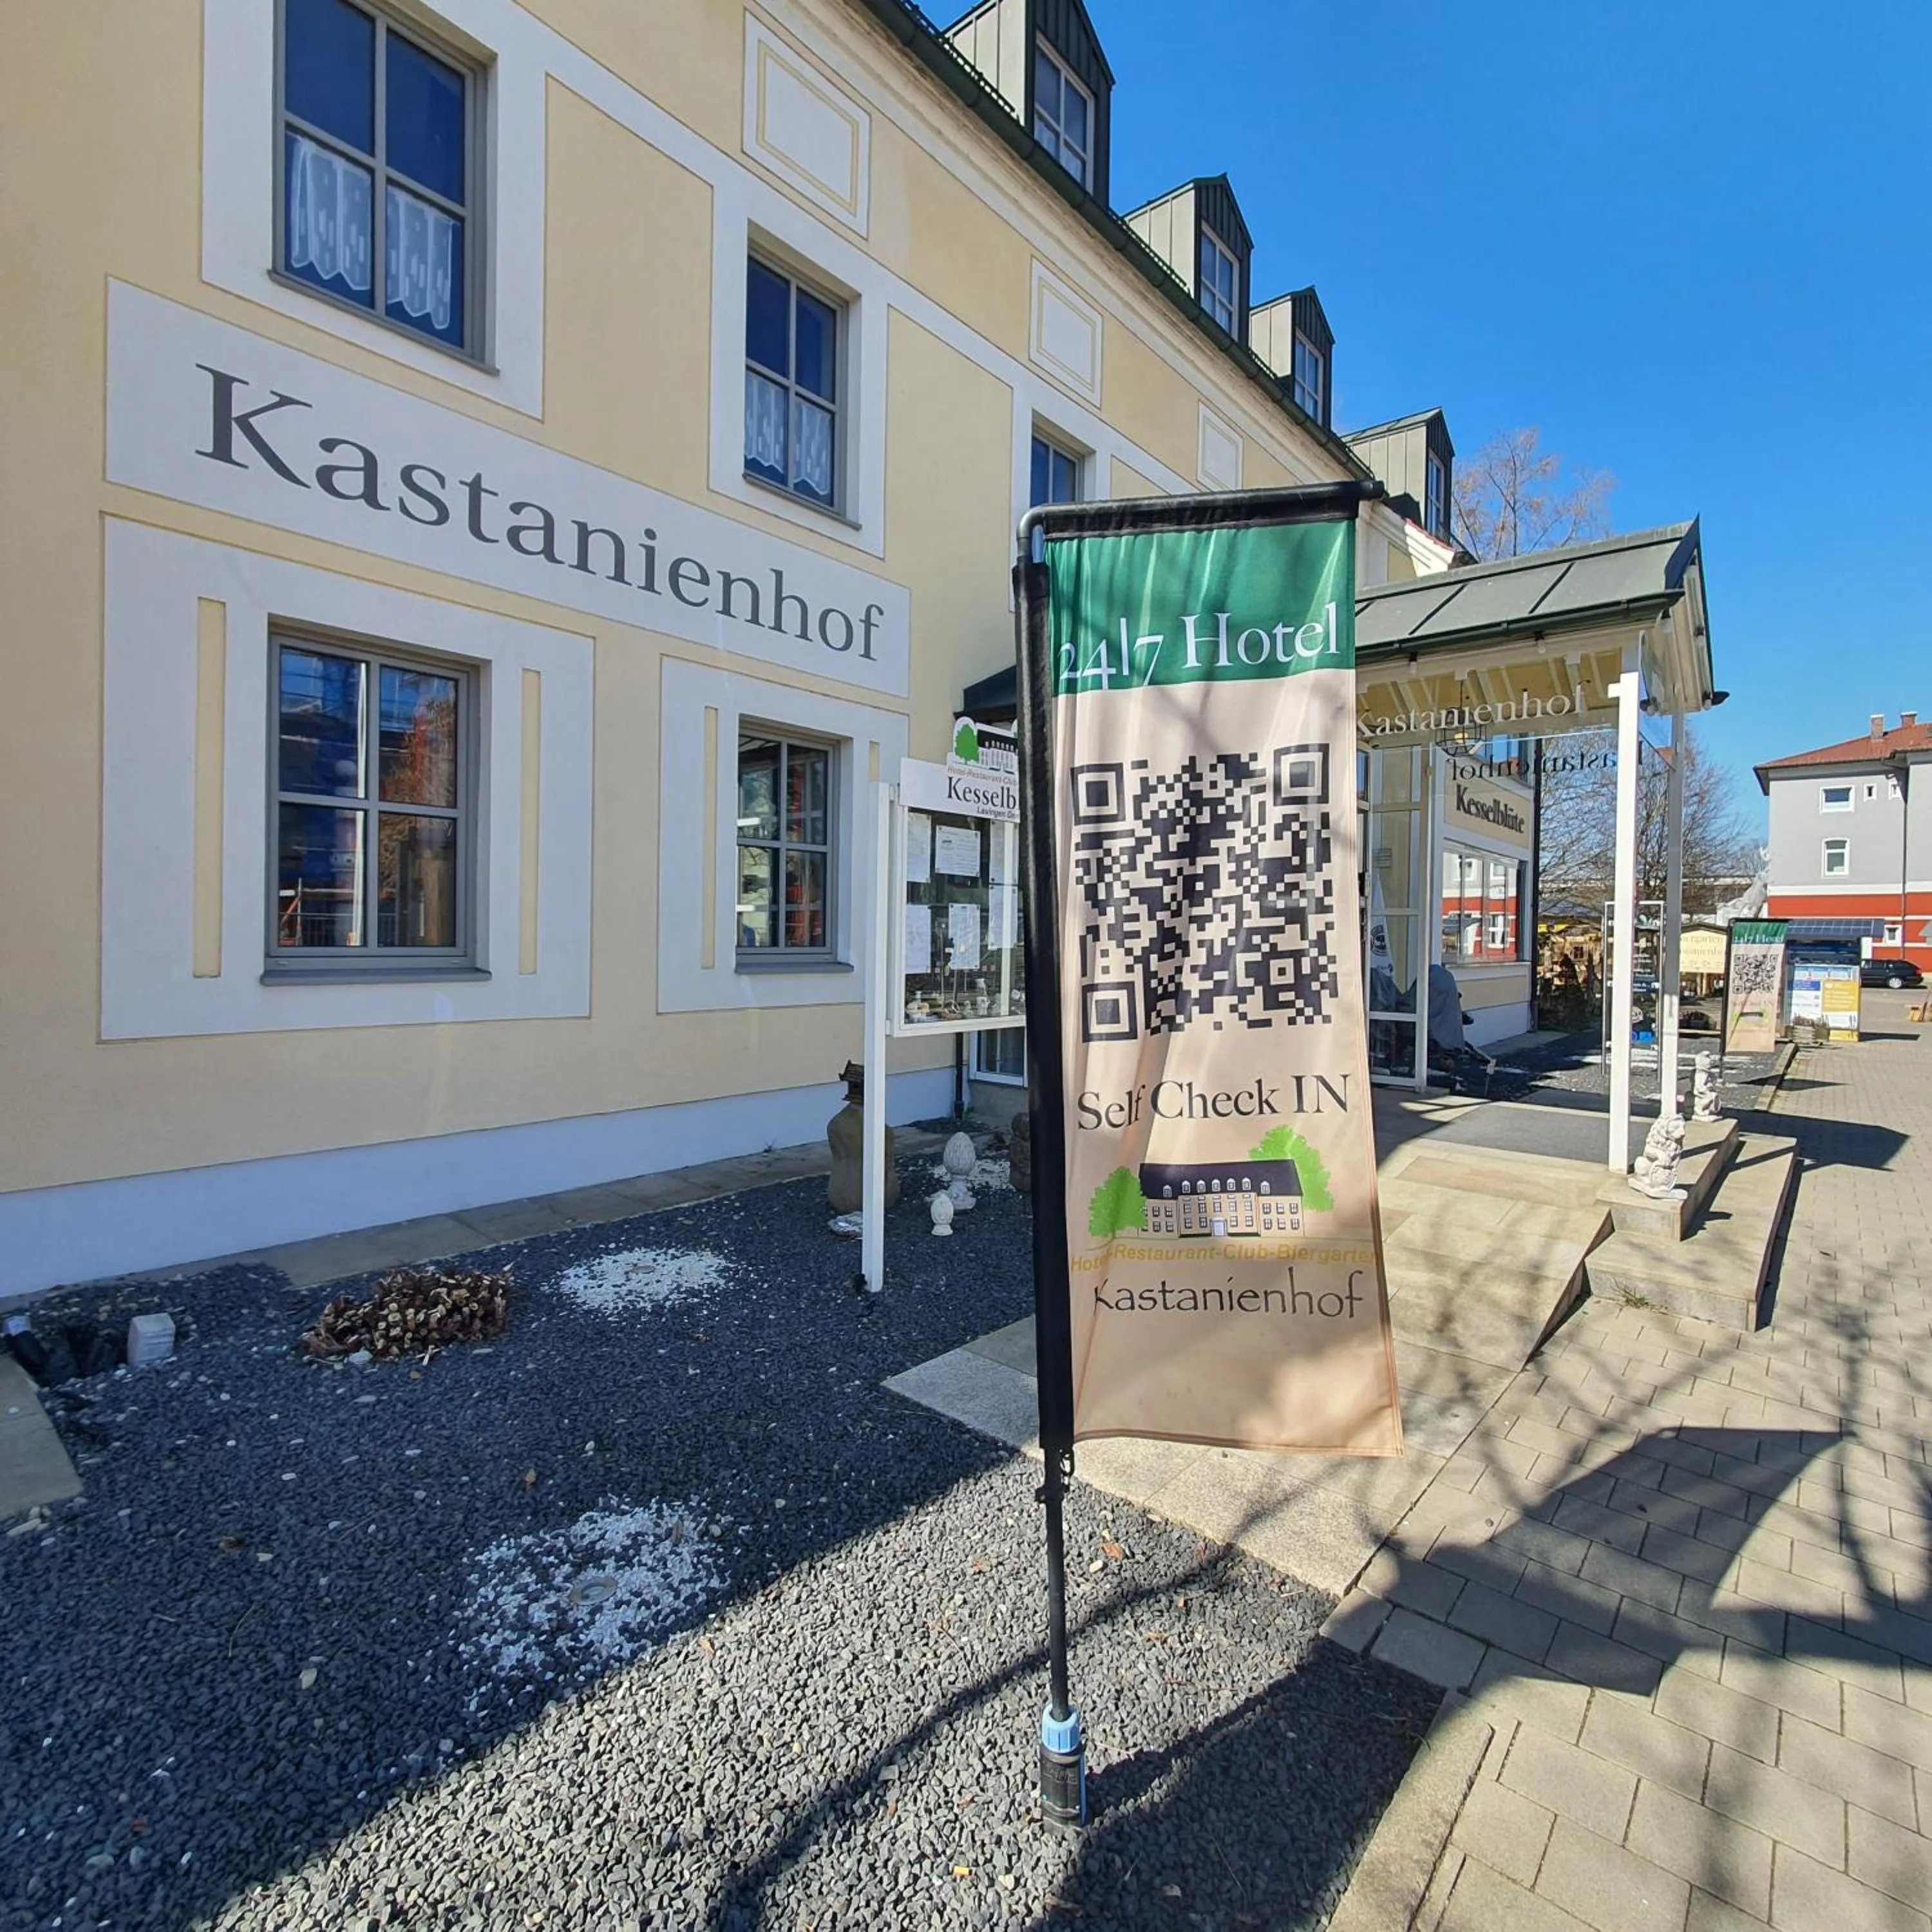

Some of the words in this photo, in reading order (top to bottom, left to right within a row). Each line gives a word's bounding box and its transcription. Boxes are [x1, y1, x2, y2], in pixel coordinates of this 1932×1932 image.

[195, 363, 884, 661] Kastanienhof
[1180, 601, 1340, 668] Hotel
[947, 776, 1017, 810] Kesselb
[1456, 784, 1525, 833] Kesselblüte
[1077, 1084, 1146, 1130] Self
[1151, 1078, 1281, 1119] Check
[1291, 1074, 1350, 1113] IN
[1095, 1266, 1364, 1318] Kastanienhof
